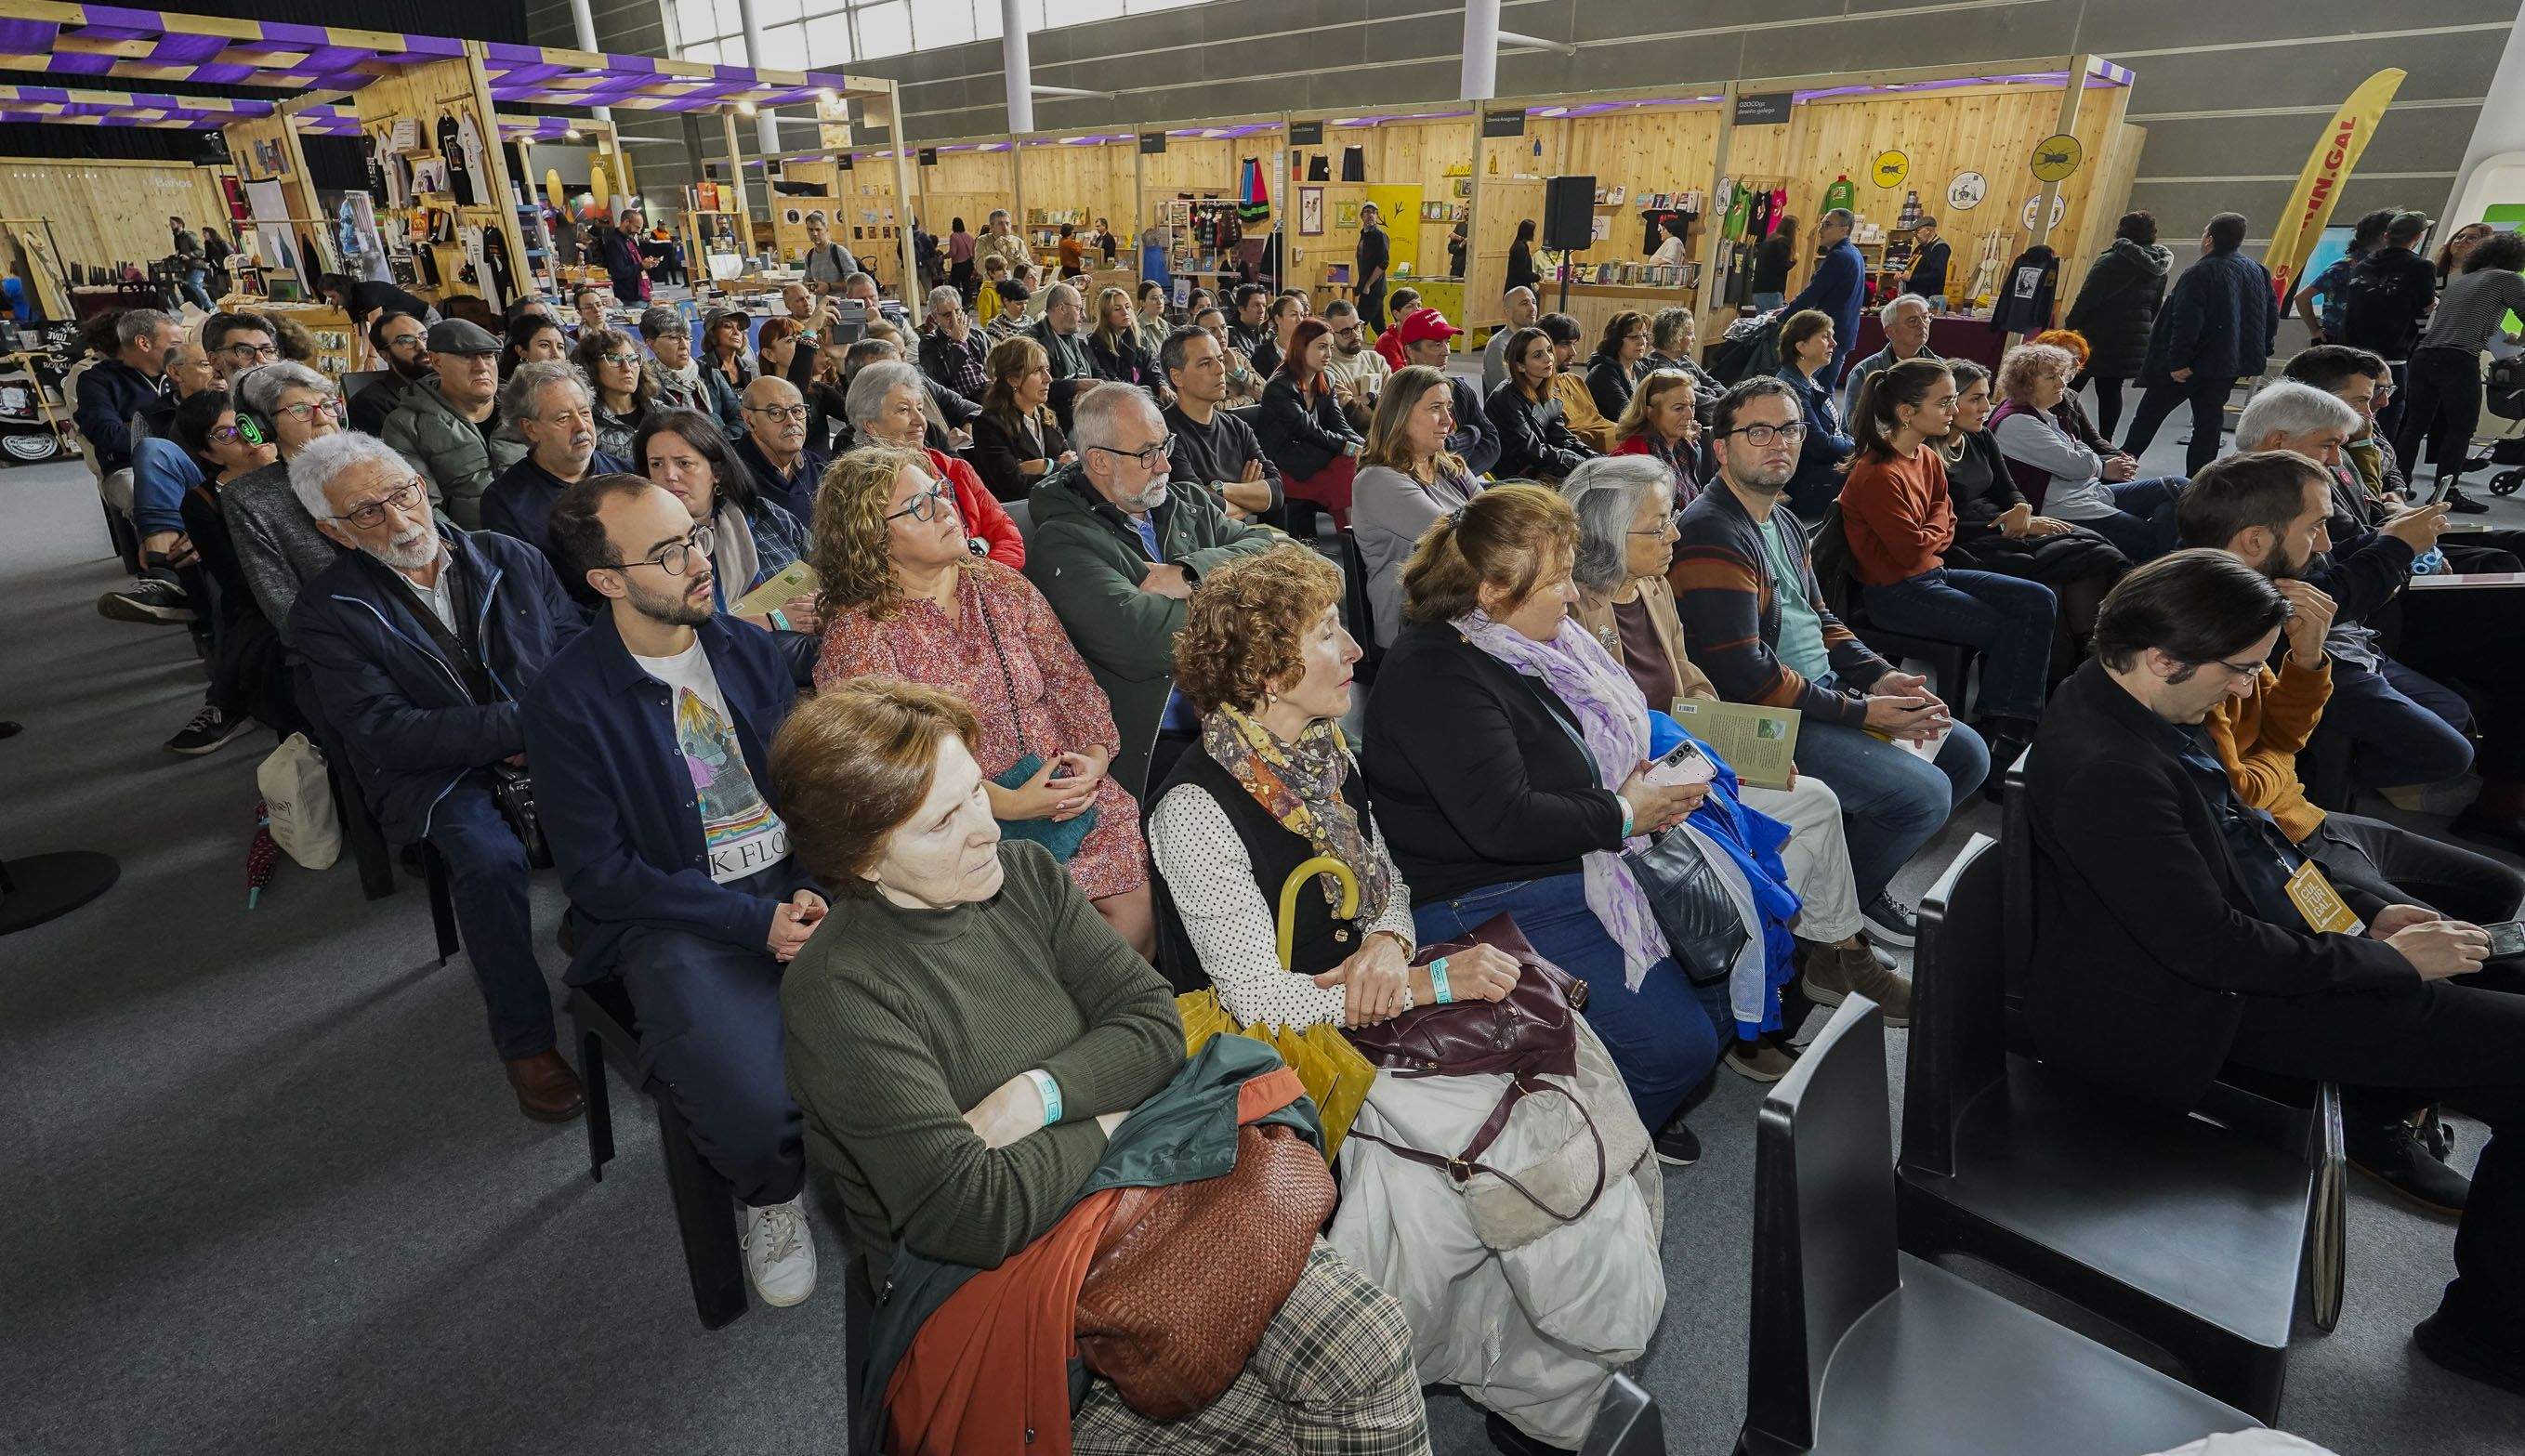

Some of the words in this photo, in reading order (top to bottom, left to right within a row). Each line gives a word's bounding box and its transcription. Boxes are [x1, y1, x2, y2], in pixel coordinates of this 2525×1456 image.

[709, 850, 735, 876] K
[2301, 882, 2319, 899] CUL
[2307, 889, 2326, 907] TUR
[2314, 901, 2332, 918] GAL
